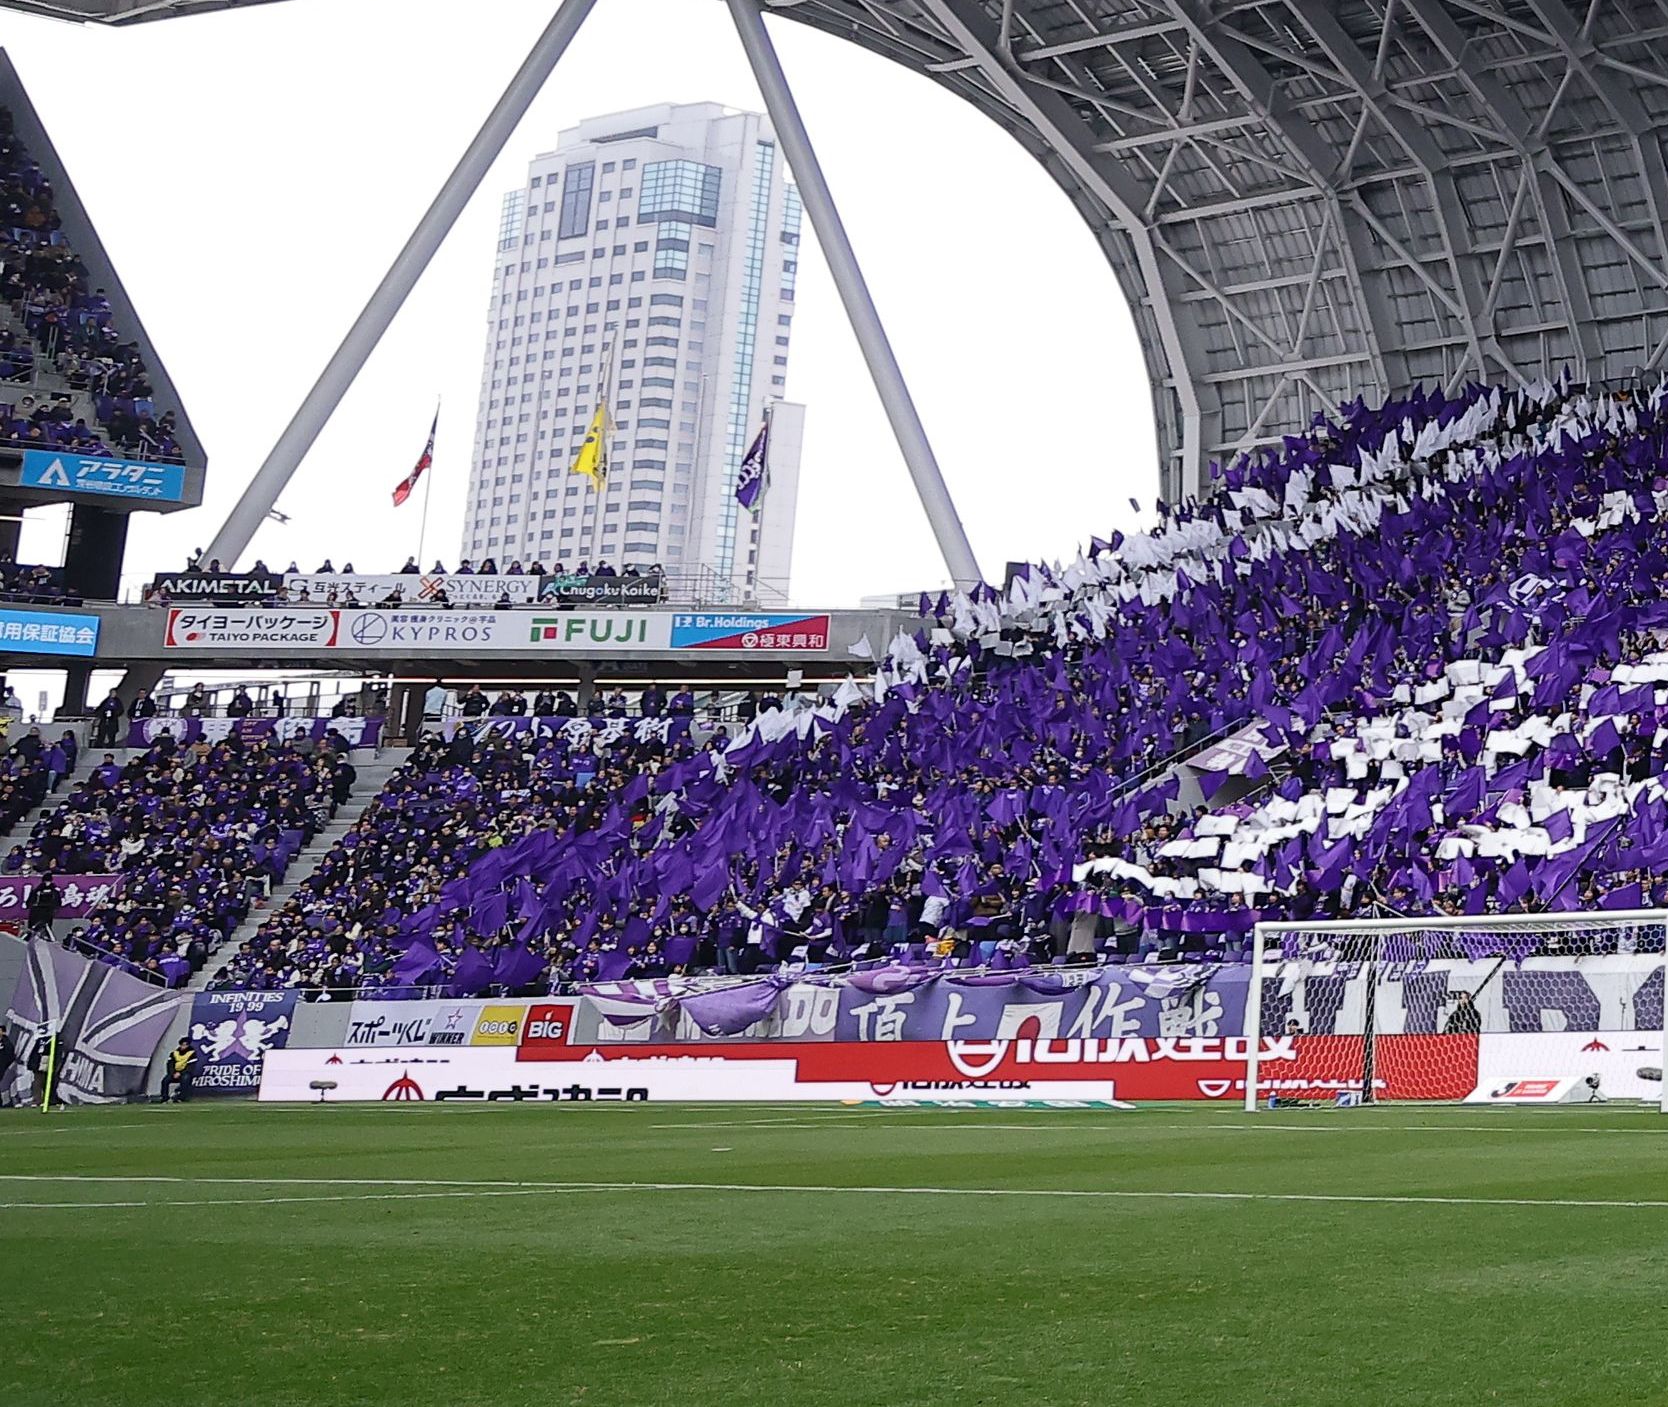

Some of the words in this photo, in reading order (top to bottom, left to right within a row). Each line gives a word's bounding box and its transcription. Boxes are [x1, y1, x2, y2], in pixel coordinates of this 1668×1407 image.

[76, 459, 166, 485] アラタニ
[161, 578, 278, 594] AKIMETAL
[446, 580, 533, 593] SYNERGY
[696, 616, 769, 629] Br.Holdings
[210, 633, 251, 642] TAIYO
[253, 633, 318, 642] PACKAGE
[392, 626, 492, 641] KYPROS
[564, 619, 647, 643] FUJI
[760, 633, 824, 648] 極東興和
[210, 992, 285, 1004] INFINITIES
[348, 1015, 433, 1045] スポーツくじ
[528, 1021, 563, 1039] BIG
[429, 1033, 465, 1044] WINNER
[202, 1064, 240, 1075] PRIDE
[243, 1064, 261, 1075] OF
